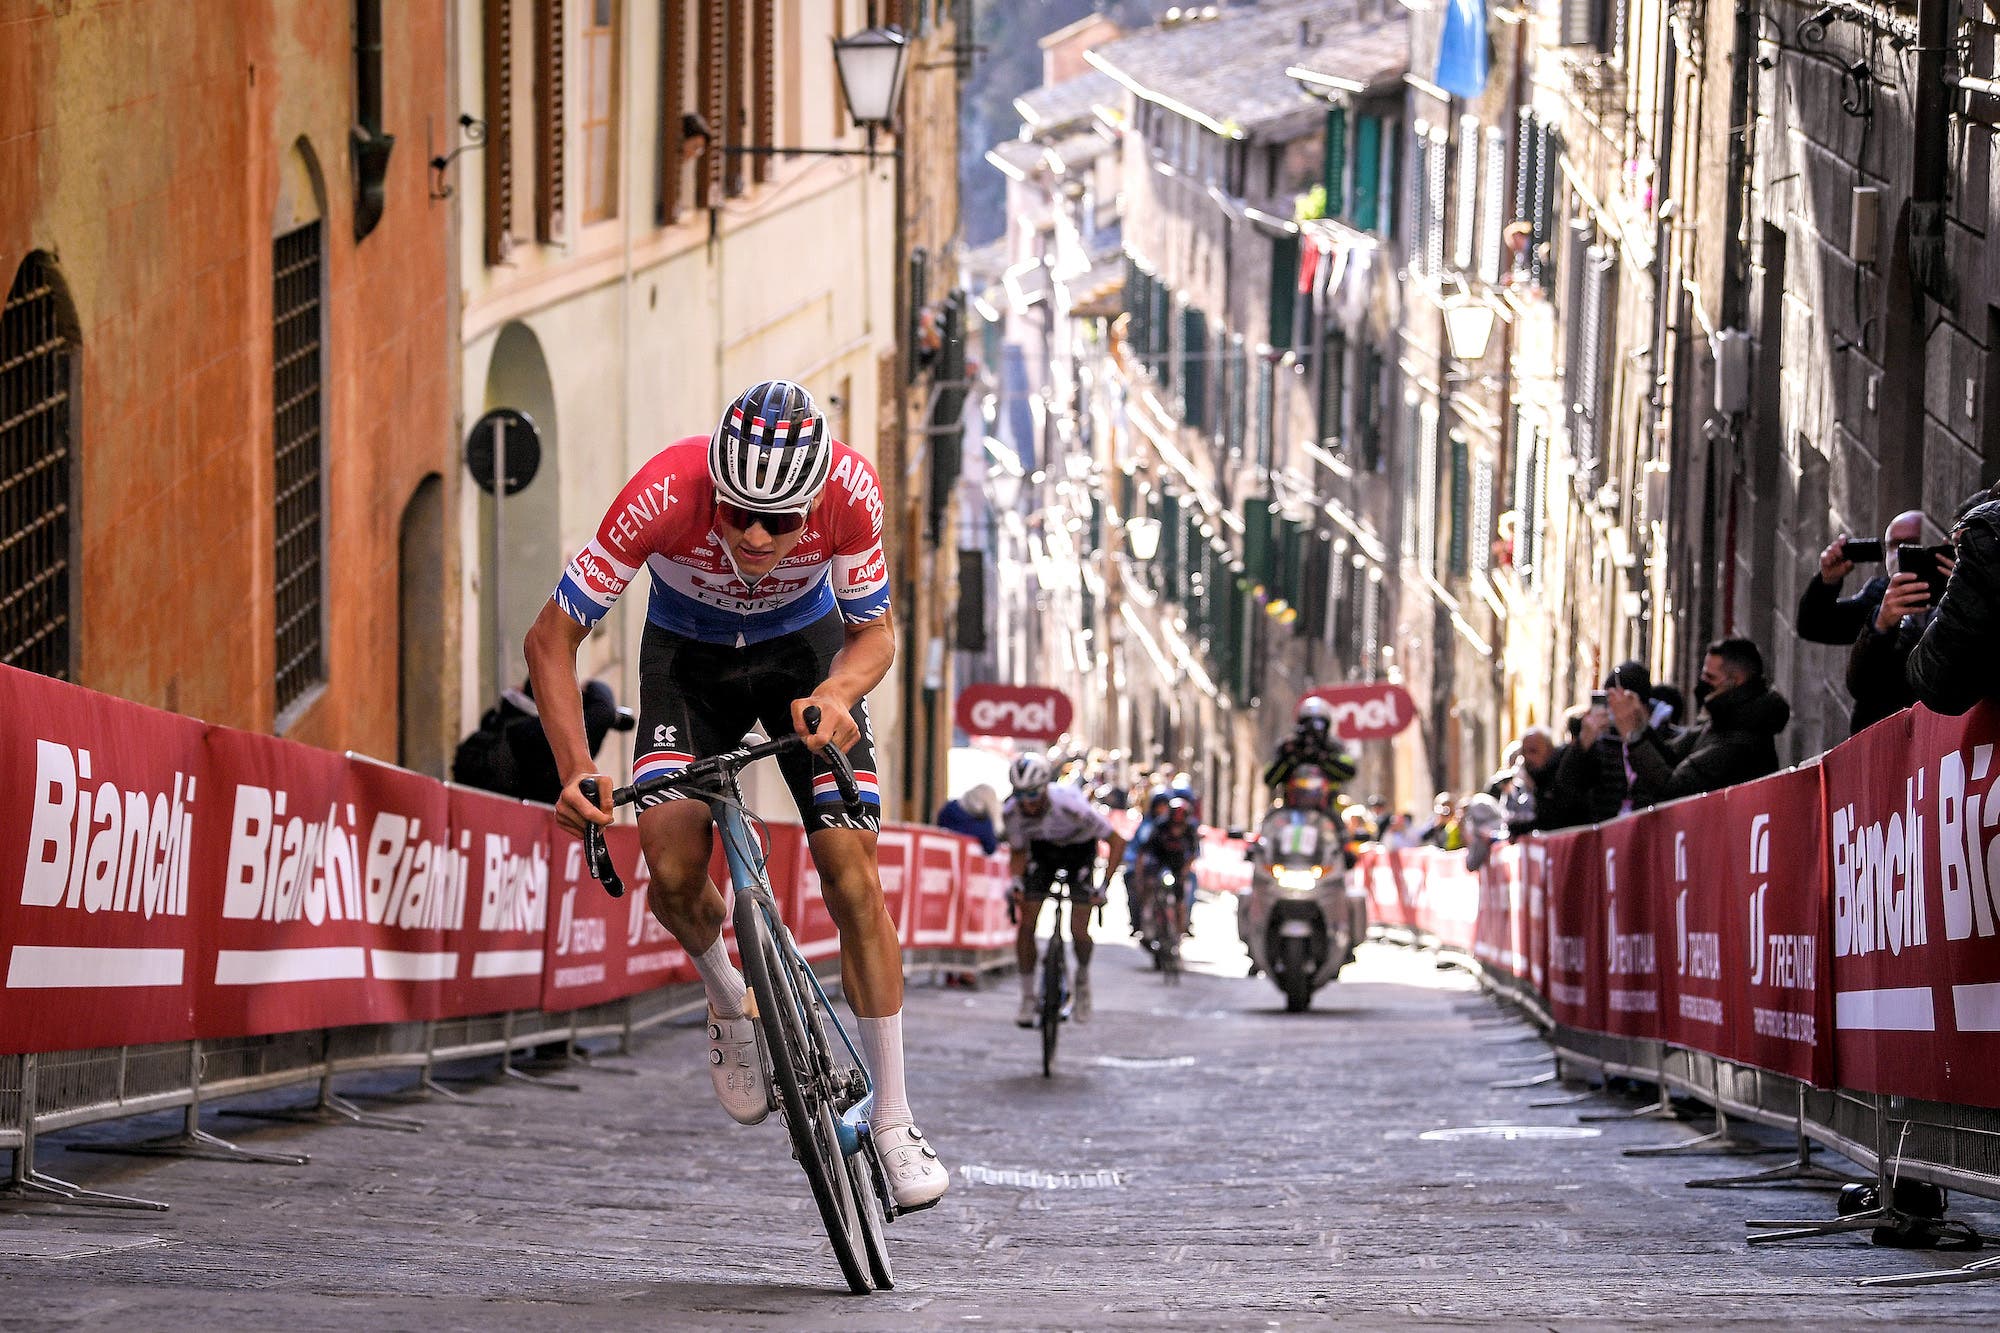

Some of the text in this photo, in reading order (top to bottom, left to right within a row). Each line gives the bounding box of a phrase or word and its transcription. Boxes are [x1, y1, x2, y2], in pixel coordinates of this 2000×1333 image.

[608, 475, 679, 552] FENIX
[579, 553, 624, 593] Alpecin
[971, 697, 1056, 732] enel
[1326, 690, 1400, 732] nel
[20, 739, 196, 921] Bianchi
[820, 812, 880, 833] CAN
[222, 784, 363, 927] Bianchi
[1833, 767, 1927, 957] Bianchi
